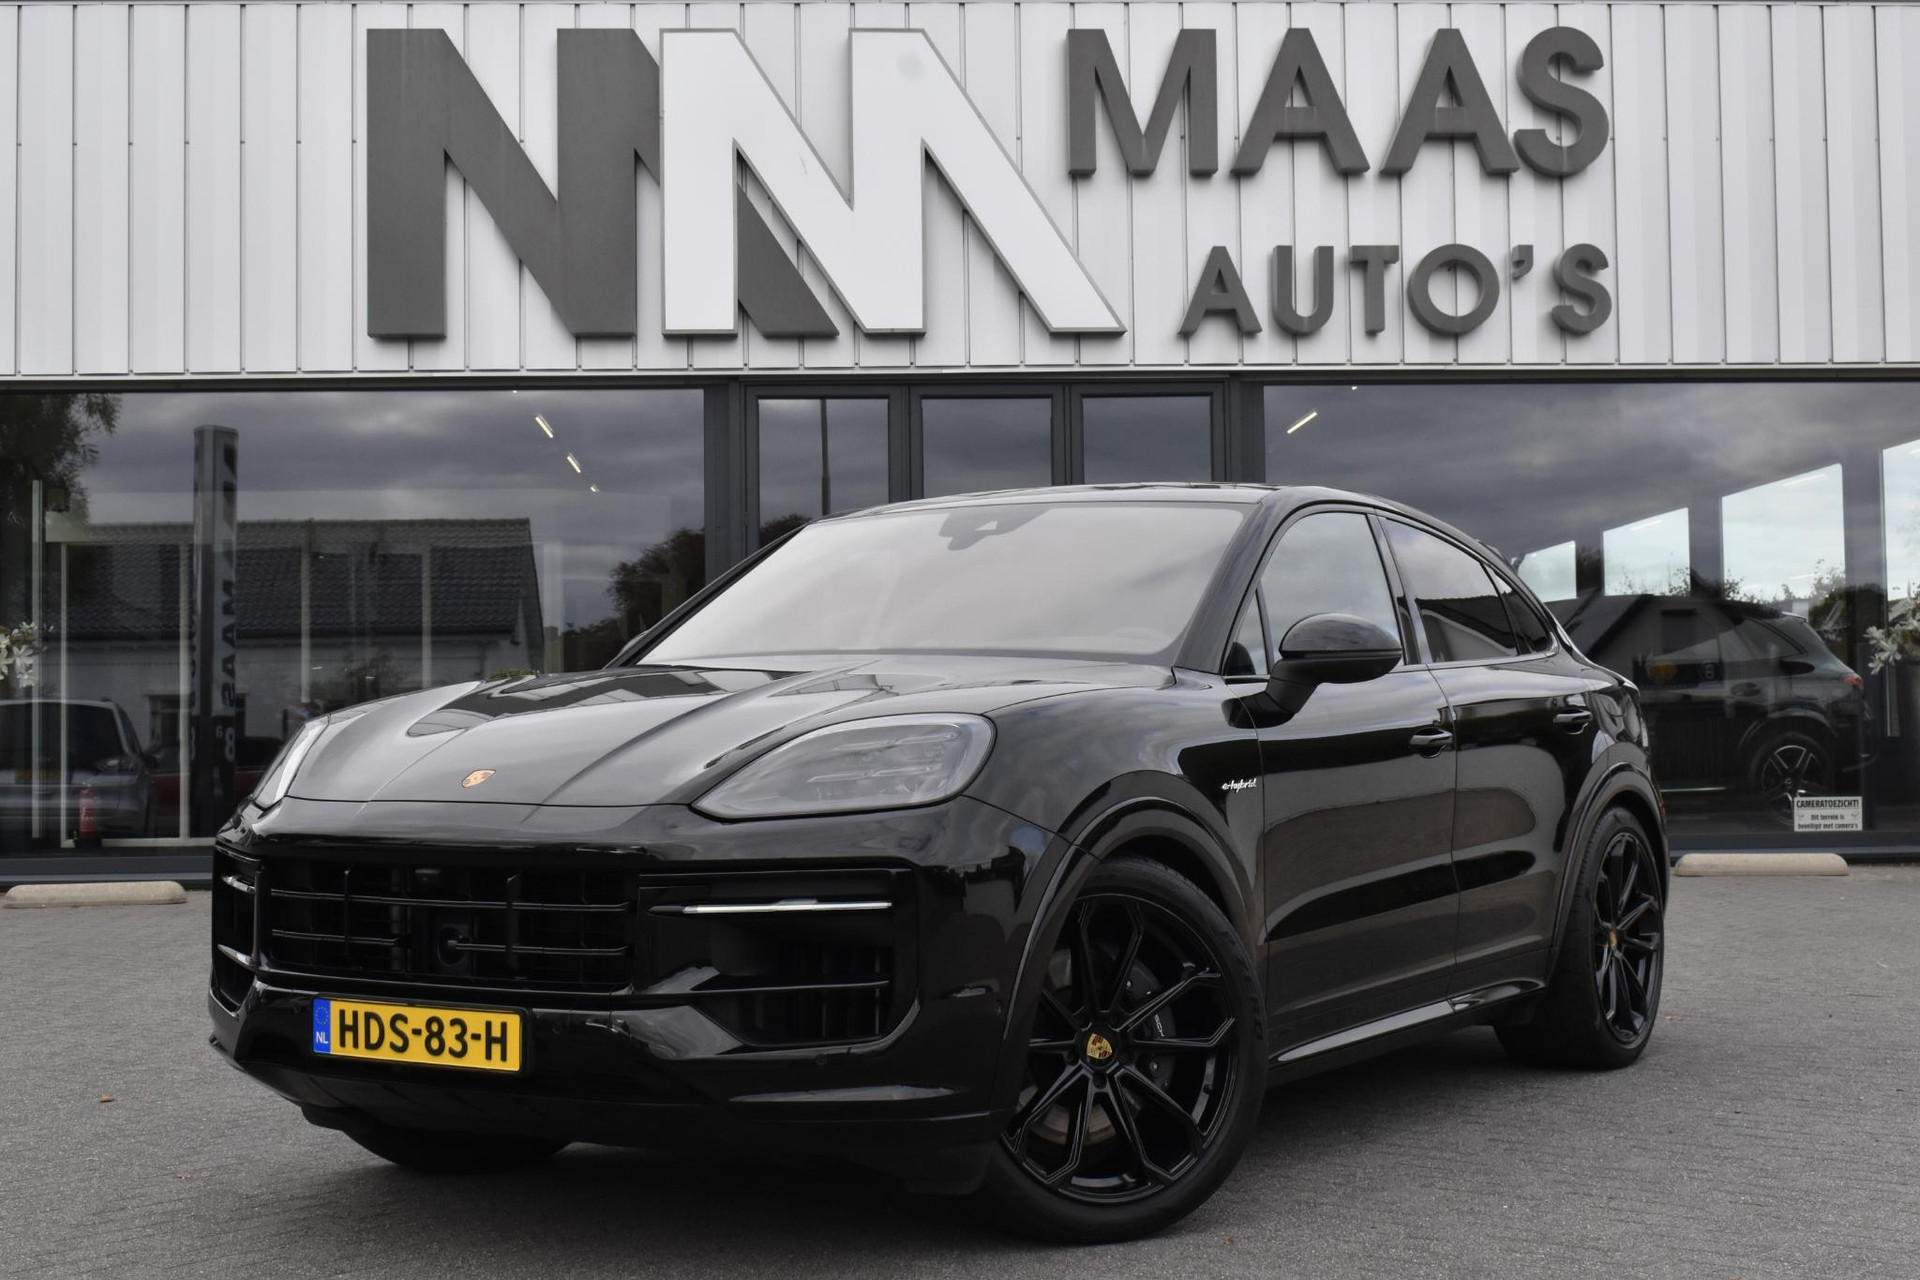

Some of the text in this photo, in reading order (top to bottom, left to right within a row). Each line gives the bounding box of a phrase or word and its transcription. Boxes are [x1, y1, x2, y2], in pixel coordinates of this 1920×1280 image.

[1065, 26, 1610, 178] MAAS
[1178, 243, 1613, 336] AUTO'S
[1796, 799, 1859, 809] CAMERATOEZICHT!
[315, 1030, 329, 1045] NL
[338, 1008, 508, 1062] HDS-83-H
